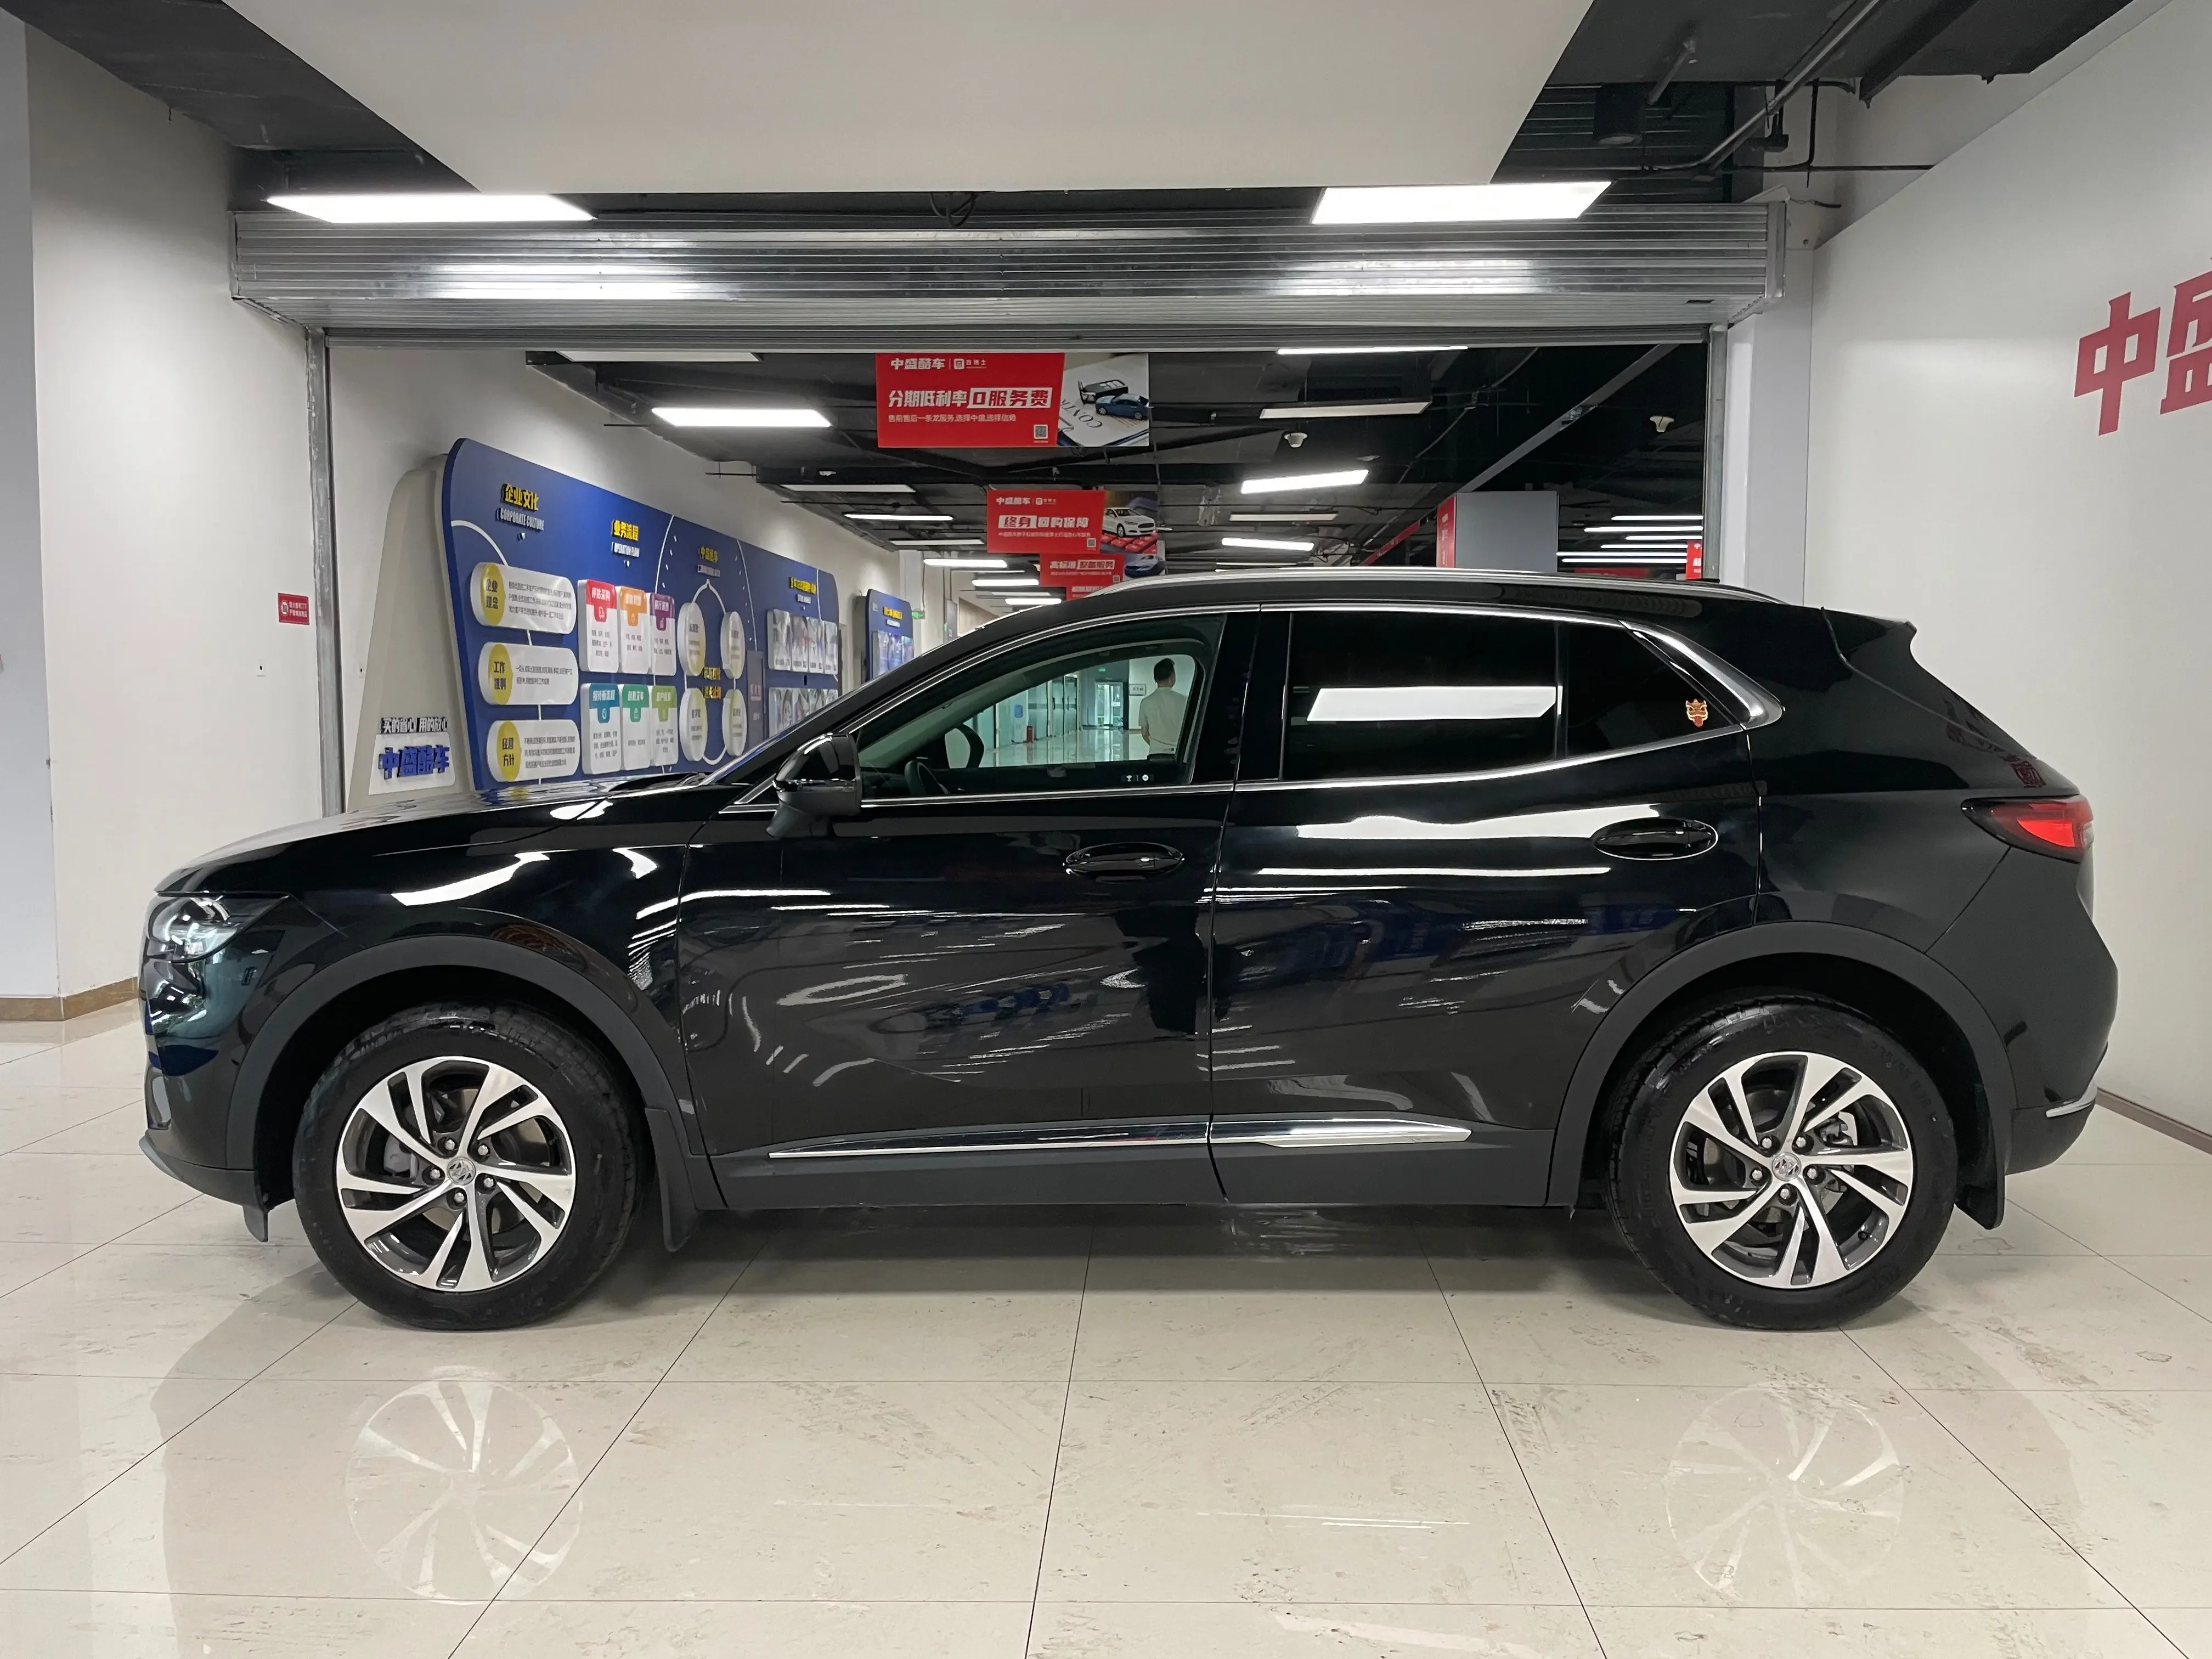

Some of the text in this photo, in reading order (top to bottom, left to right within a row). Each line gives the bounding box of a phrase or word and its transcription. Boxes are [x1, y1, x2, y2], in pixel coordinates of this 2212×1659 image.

[890, 358, 945, 370] 中盛酷车
[505, 484, 539, 511] 企业文化
[494, 662, 505, 674] 工作
[381, 744, 450, 780] 中盛酷车
[503, 753, 515, 766] 方针
